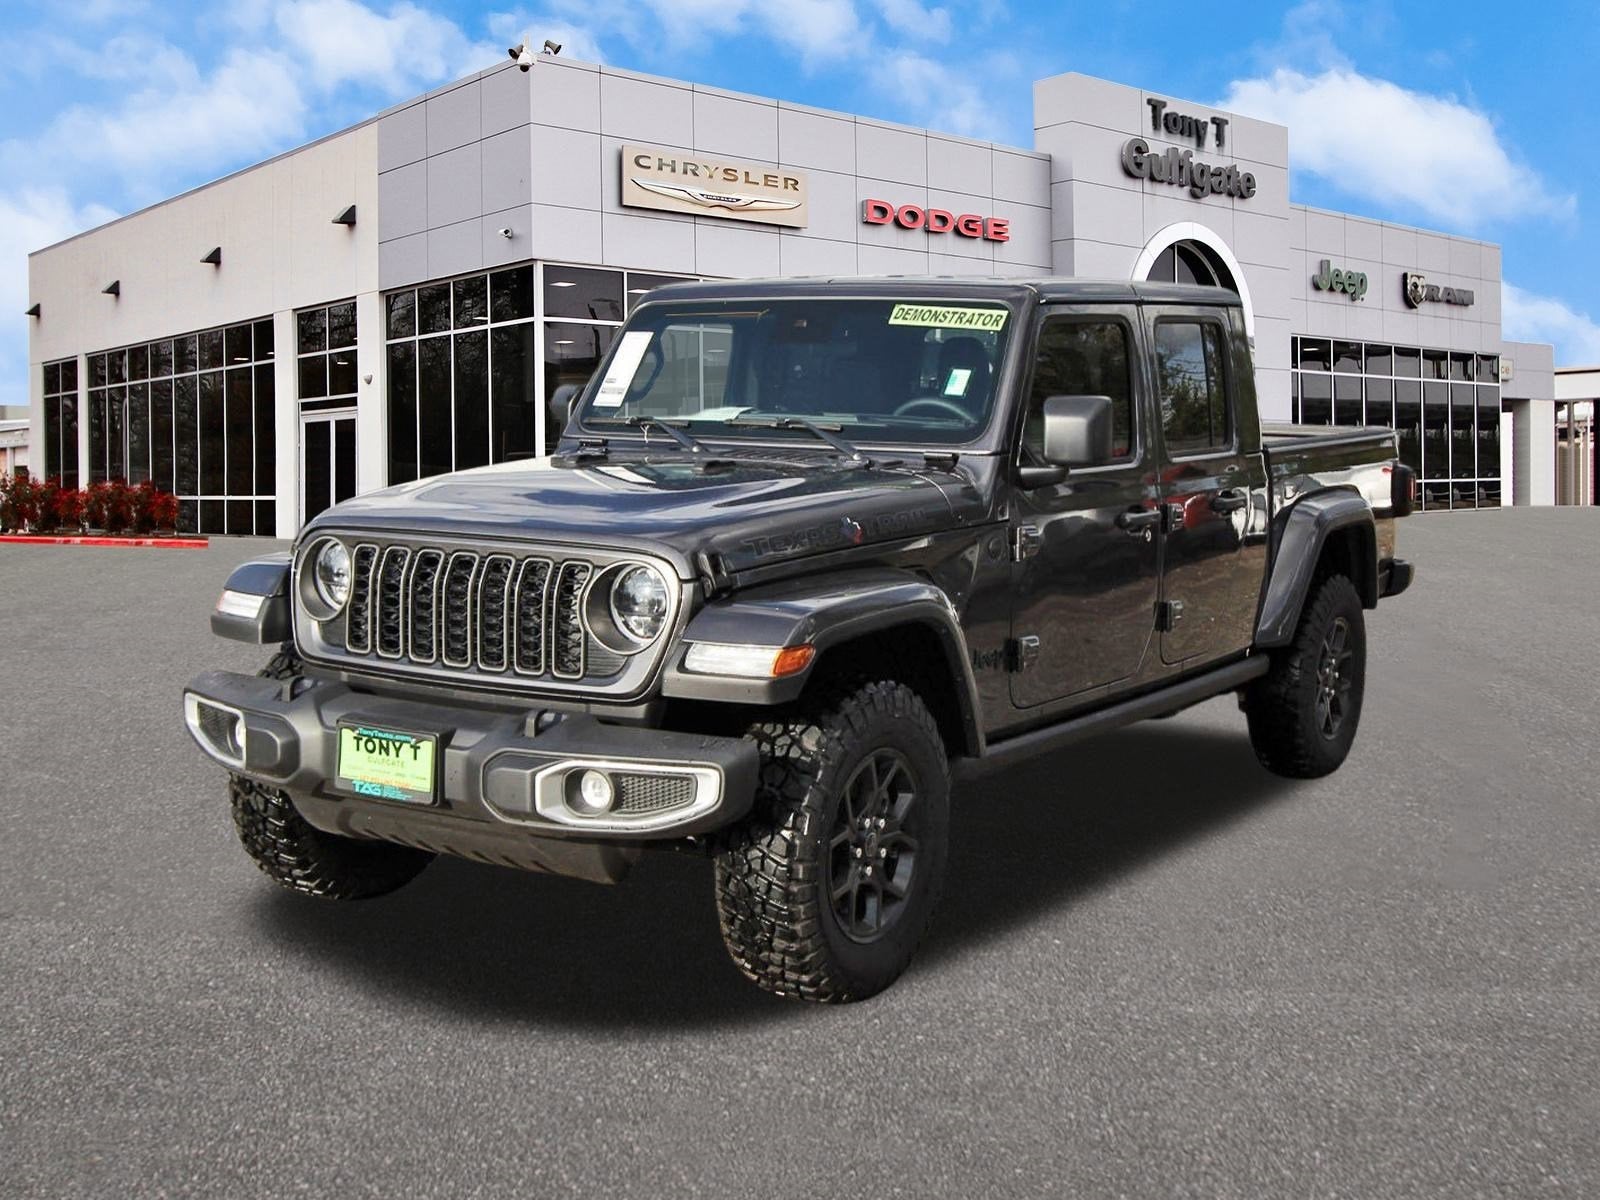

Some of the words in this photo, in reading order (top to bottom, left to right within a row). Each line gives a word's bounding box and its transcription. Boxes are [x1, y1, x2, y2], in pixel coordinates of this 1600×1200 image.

[1146, 97, 1209, 148] Tony
[1210, 116, 1229, 147] T
[633, 153, 800, 192] CHRYSLER
[1121, 137, 1256, 199] Gulfgate
[862, 198, 1010, 242] DODGE
[1312, 259, 1368, 302] Jeep
[1424, 283, 1475, 306] RAM
[893, 307, 1003, 328] DEMONSTRATOR
[353, 736, 404, 758] TONY
[410, 744, 421, 761] T
